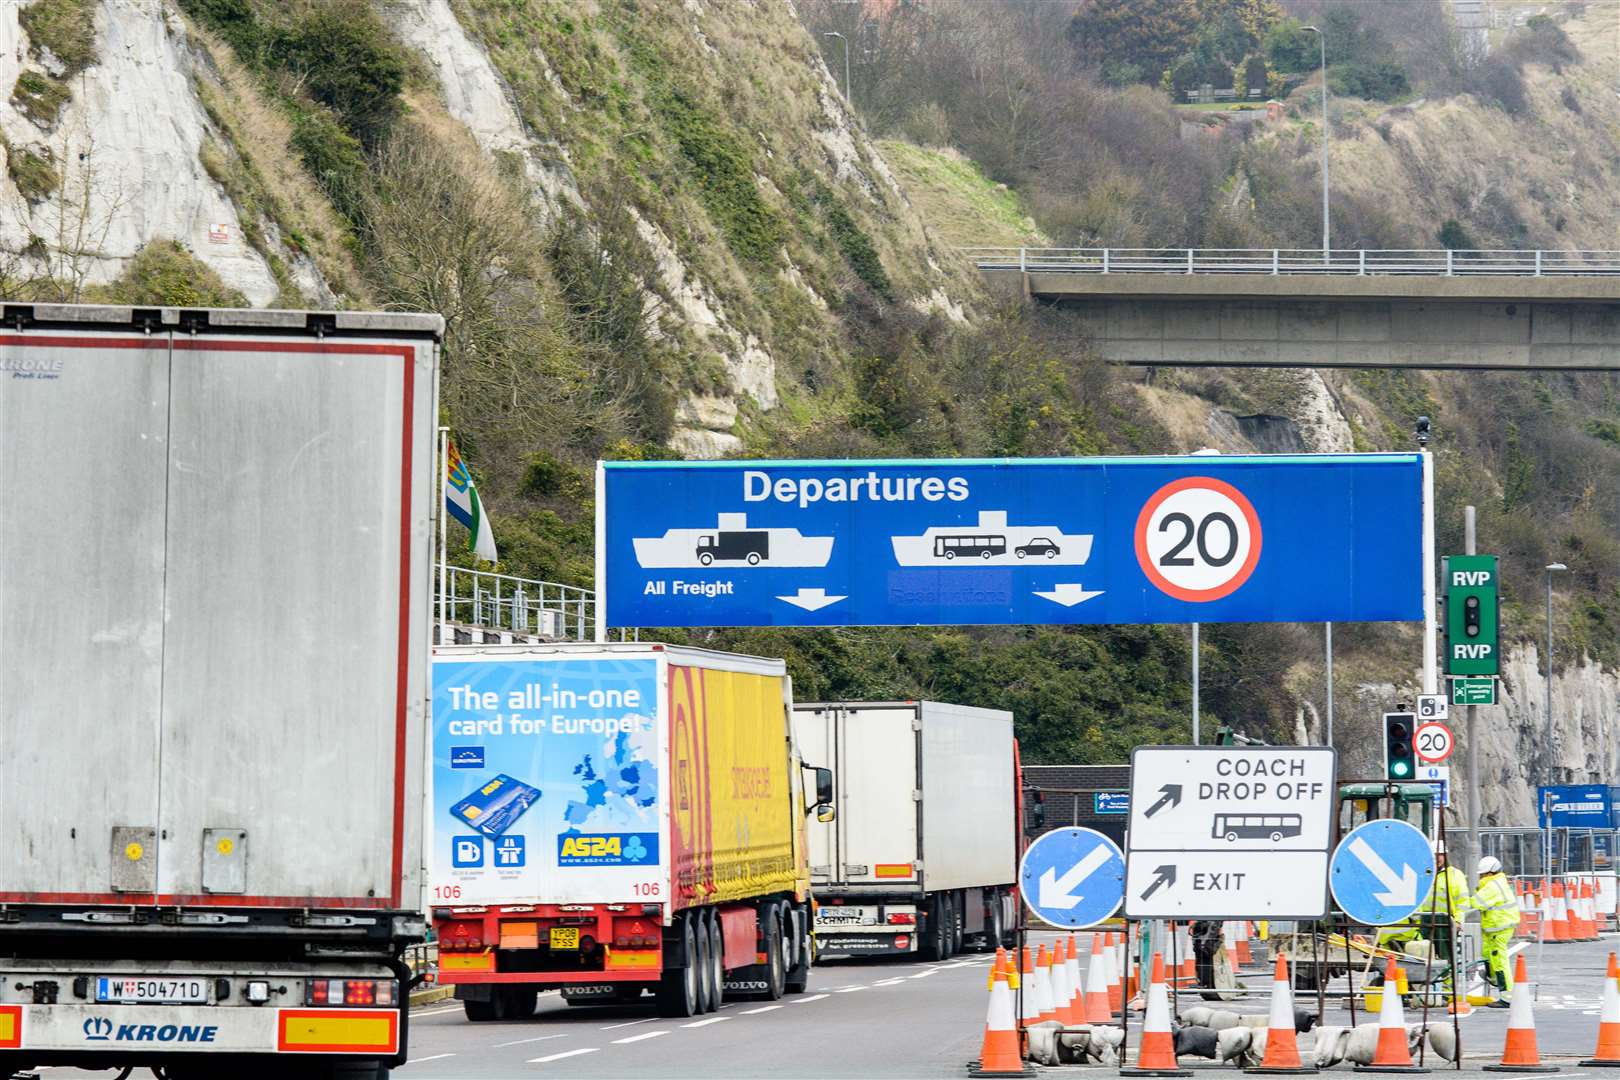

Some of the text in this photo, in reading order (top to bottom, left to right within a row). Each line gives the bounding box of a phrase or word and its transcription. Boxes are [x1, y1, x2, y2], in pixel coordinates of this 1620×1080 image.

[743, 471, 969, 508] Departures
[1158, 513, 1238, 566] 20
[1453, 571, 1490, 586] RVP
[643, 580, 734, 597] All Freight
[1454, 644, 1491, 659] RVP
[448, 683, 641, 711] The all-in-one
[449, 713, 640, 739] card for Europe!
[1420, 733, 1447, 752] 20
[1216, 758, 1305, 777] COACH
[1199, 782, 1323, 801] DROP OFF
[560, 837, 622, 857] AS24
[632, 883, 660, 896] 106
[1193, 873, 1246, 890] EXIT
[434, 885, 462, 899] 106
[112, 981, 200, 998] W 50471D
[564, 985, 613, 995] VOLVO
[721, 981, 768, 990] VOLVO
[115, 1024, 219, 1042] KRONE
